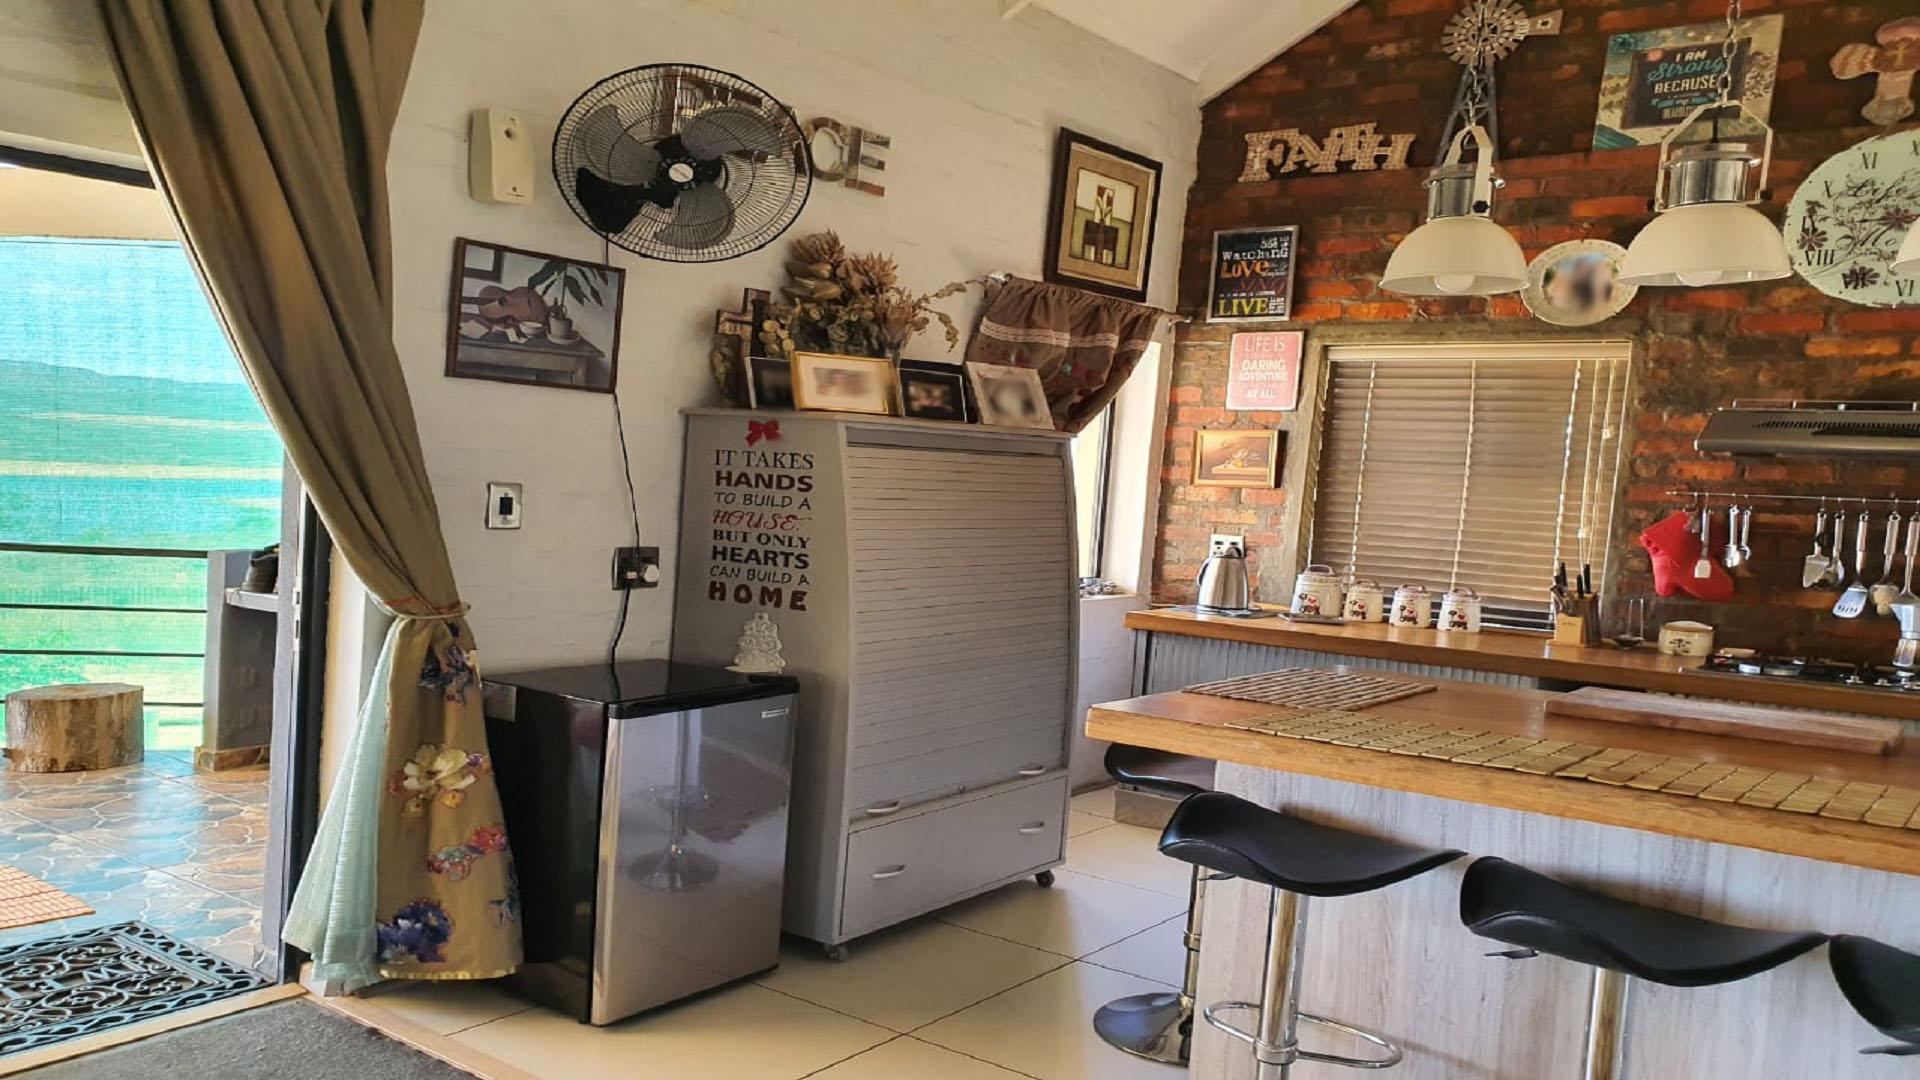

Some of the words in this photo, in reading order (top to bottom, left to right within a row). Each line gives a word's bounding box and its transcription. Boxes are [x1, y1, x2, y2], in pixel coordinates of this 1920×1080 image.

[1684, 50, 1708, 62] AM
[1646, 57, 1726, 84] Strong
[1654, 73, 1719, 94] BECAUSE
[1237, 122, 1416, 183] FAITH
[1219, 297, 1269, 316] LIVE
[1244, 336, 1272, 353] LIFE
[1274, 335, 1286, 353] IS
[1242, 359, 1287, 371] DARING
[713, 449, 737, 466] IT
[742, 450, 814, 470] TAKES
[714, 470, 814, 493] HANDS
[713, 491, 736, 505] TO
[742, 493, 793, 508] BUILD
[798, 497, 811, 511] A
[713, 529, 752, 543] BUT
[756, 532, 810, 549] ONLY
[711, 544, 810, 570] HEARTS
[709, 565, 741, 578] CAN
[746, 568, 792, 585] BUILD
[797, 574, 810, 586] A
[708, 580, 808, 612] HOME
